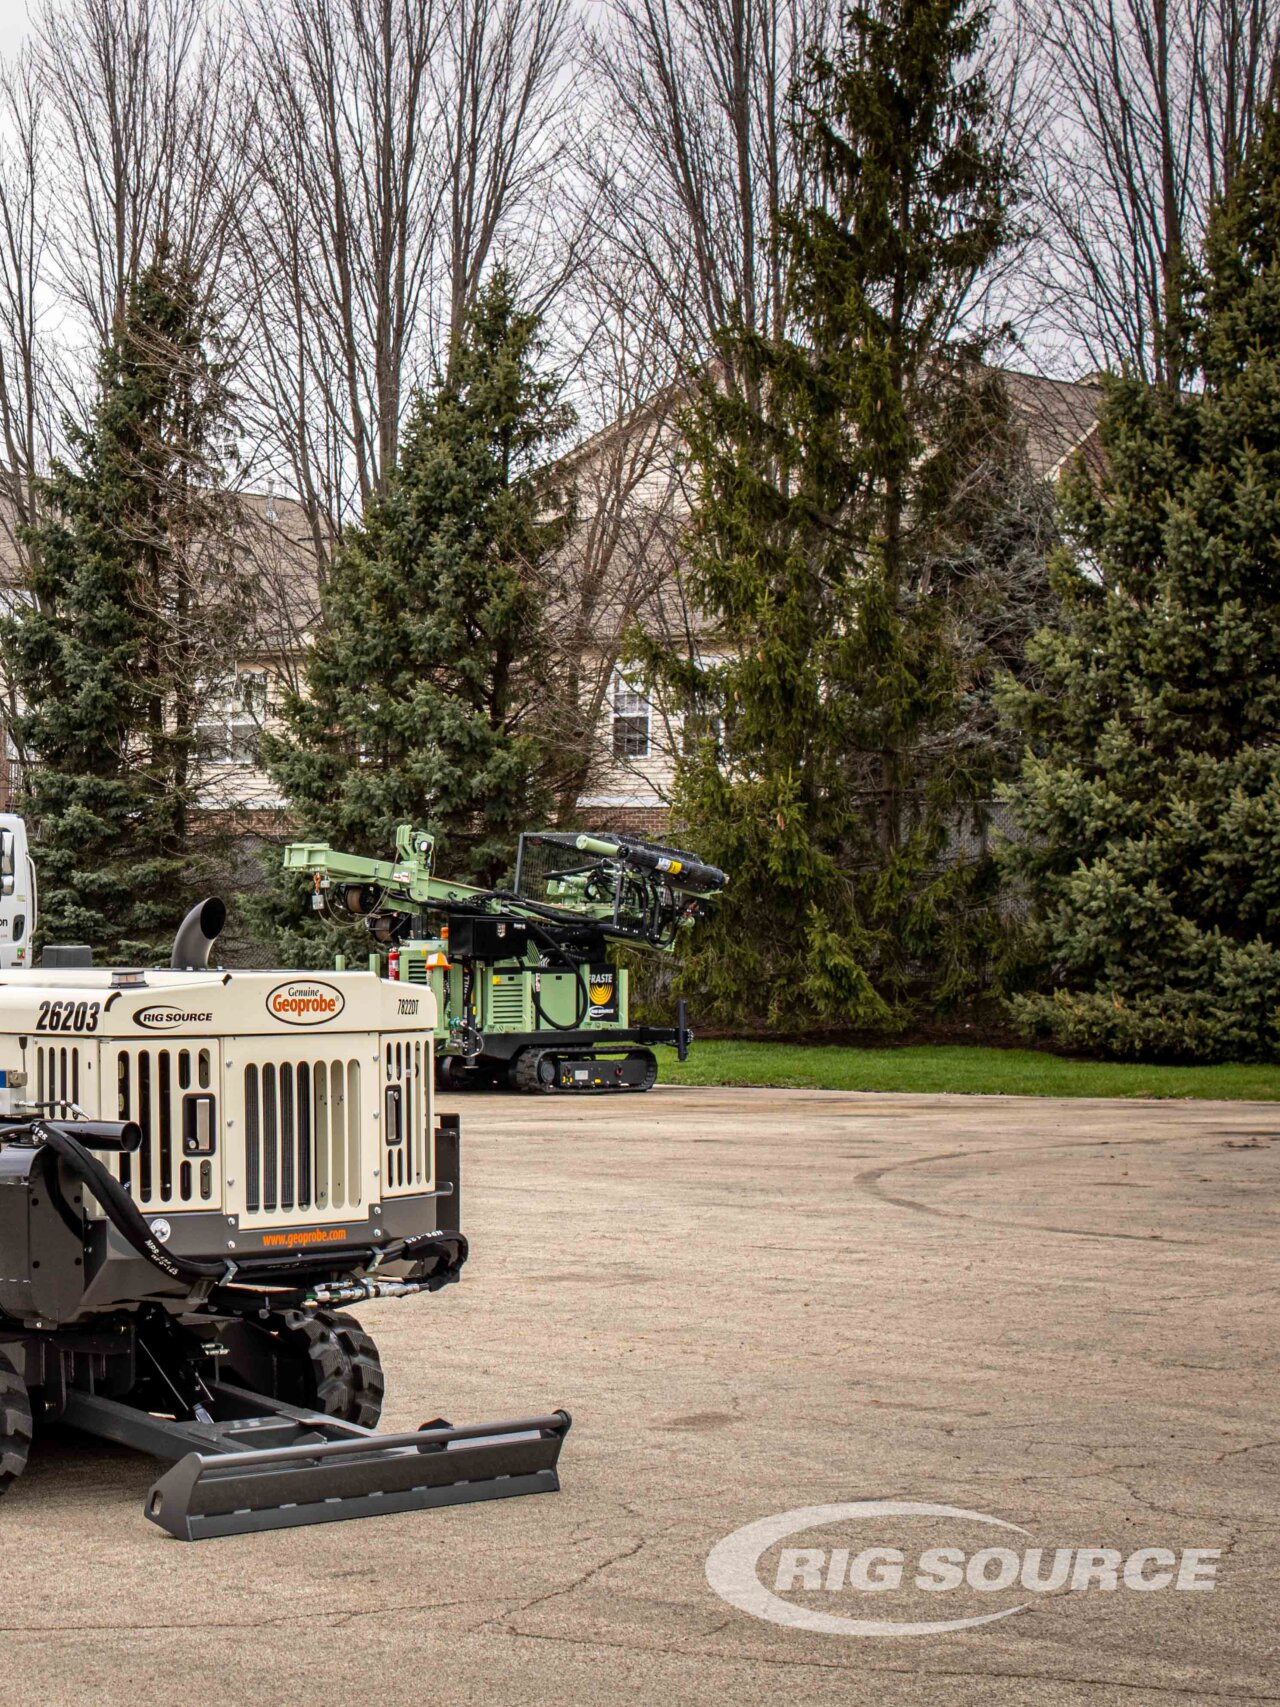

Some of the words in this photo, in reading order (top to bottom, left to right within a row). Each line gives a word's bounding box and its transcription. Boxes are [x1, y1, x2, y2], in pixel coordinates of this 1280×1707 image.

[288, 986, 320, 998] Genuine
[273, 994, 336, 1017] Geoprobe
[397, 999, 420, 1015] 7822DT
[36, 1000, 101, 1032] 26203
[143, 1013, 164, 1022] RIG
[165, 1012, 213, 1022] SOURCE
[262, 1228, 347, 1248] www.geoprobe.com
